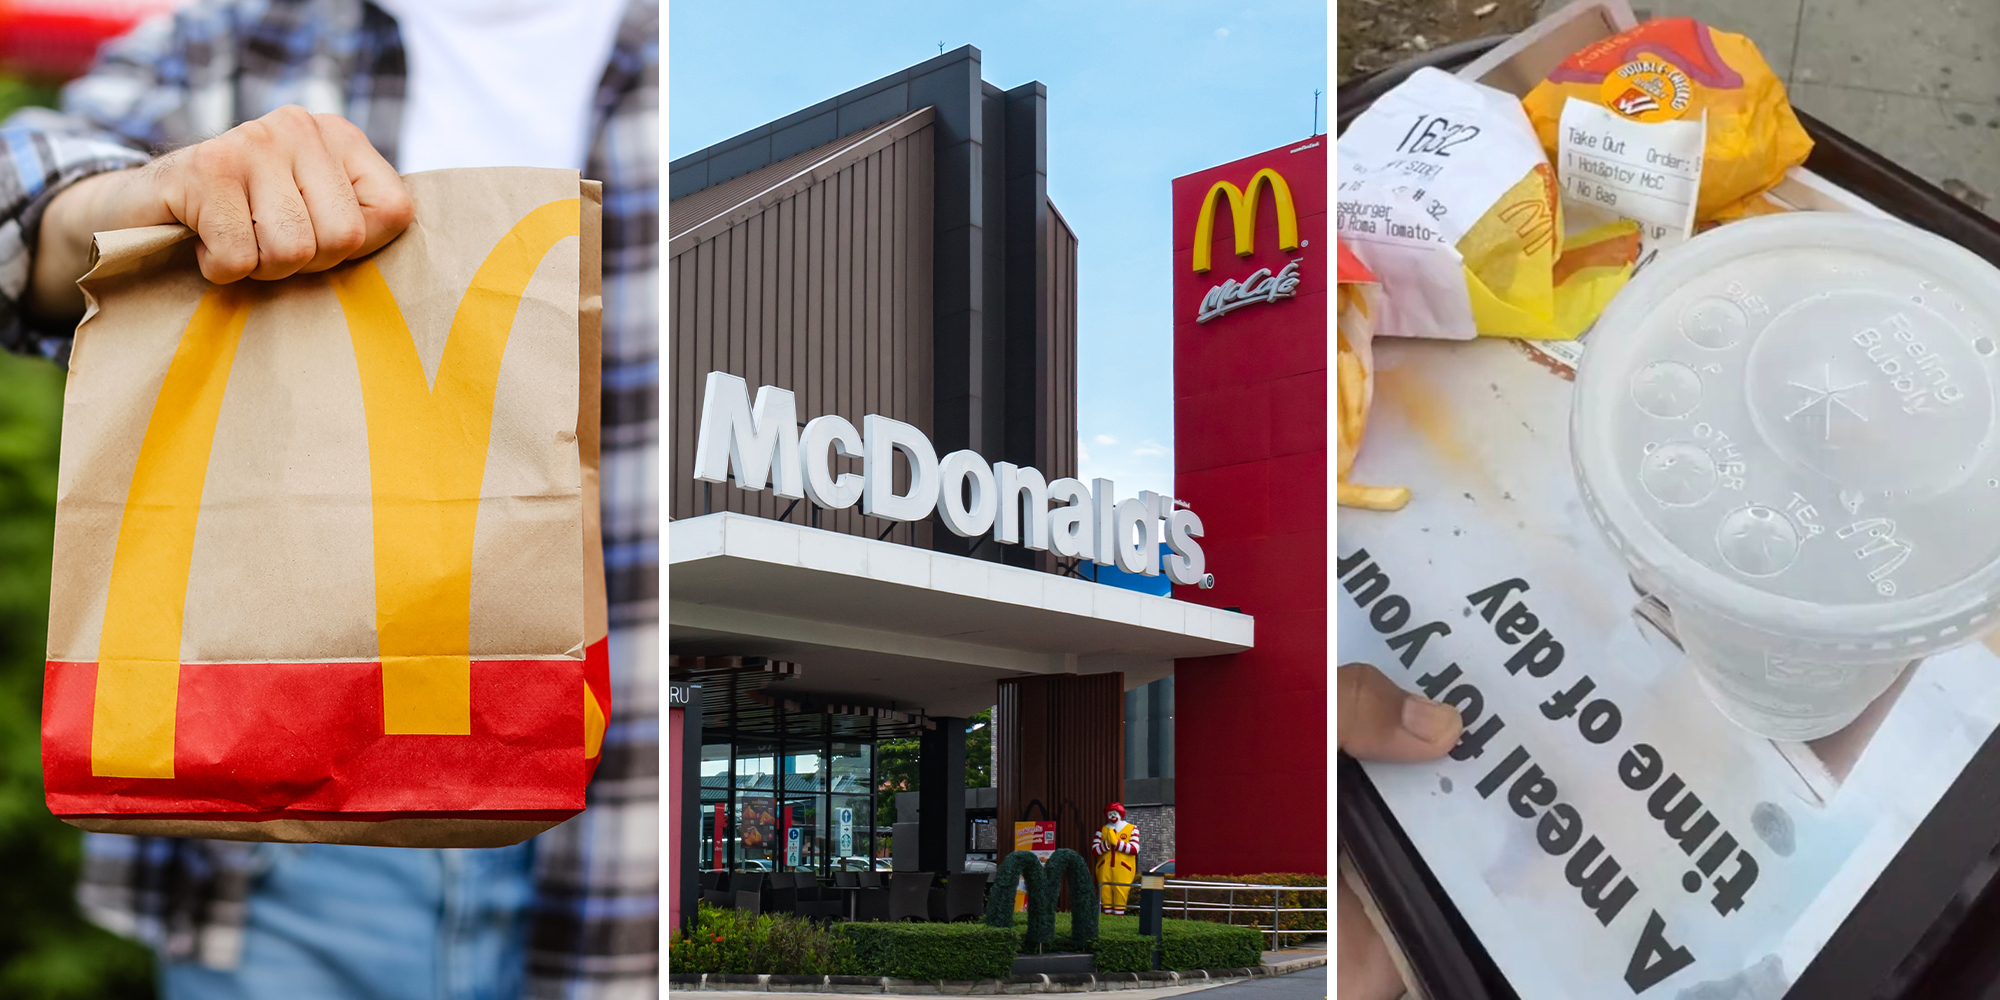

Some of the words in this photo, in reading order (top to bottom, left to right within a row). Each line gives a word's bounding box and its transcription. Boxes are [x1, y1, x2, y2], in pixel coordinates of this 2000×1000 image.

[1396, 114, 1480, 157] 1632
[1569, 127, 1597, 148] Take
[1602, 135, 1626, 155] Out
[1647, 148, 1690, 172] Order:
[1567, 177, 1572, 191] 1
[1577, 181, 1591, 198] No
[1595, 186, 1617, 205] Bag
[1568, 153, 1572, 167] 1
[1640, 172, 1665, 190] McC
[1349, 214, 1377, 234] Roma
[1426, 199, 1448, 222] 32
[1651, 226, 1667, 240] UP
[1198, 257, 1304, 320] McCafé
[1727, 281, 1769, 315] DIET
[1853, 327, 1936, 415] Bubbly
[1882, 312, 1964, 404] Feeling
[694, 370, 1206, 586] McDonald's
[1694, 422, 1746, 490] OTHER
[1786, 492, 1825, 543] TEA
[1337, 548, 1452, 670] your
[1466, 577, 1565, 677] day
[1416, 662, 1505, 761] for
[1539, 675, 1622, 744] of
[1474, 745, 1639, 928] meal
[1618, 743, 1759, 917] time
[1624, 908, 1696, 995] A
